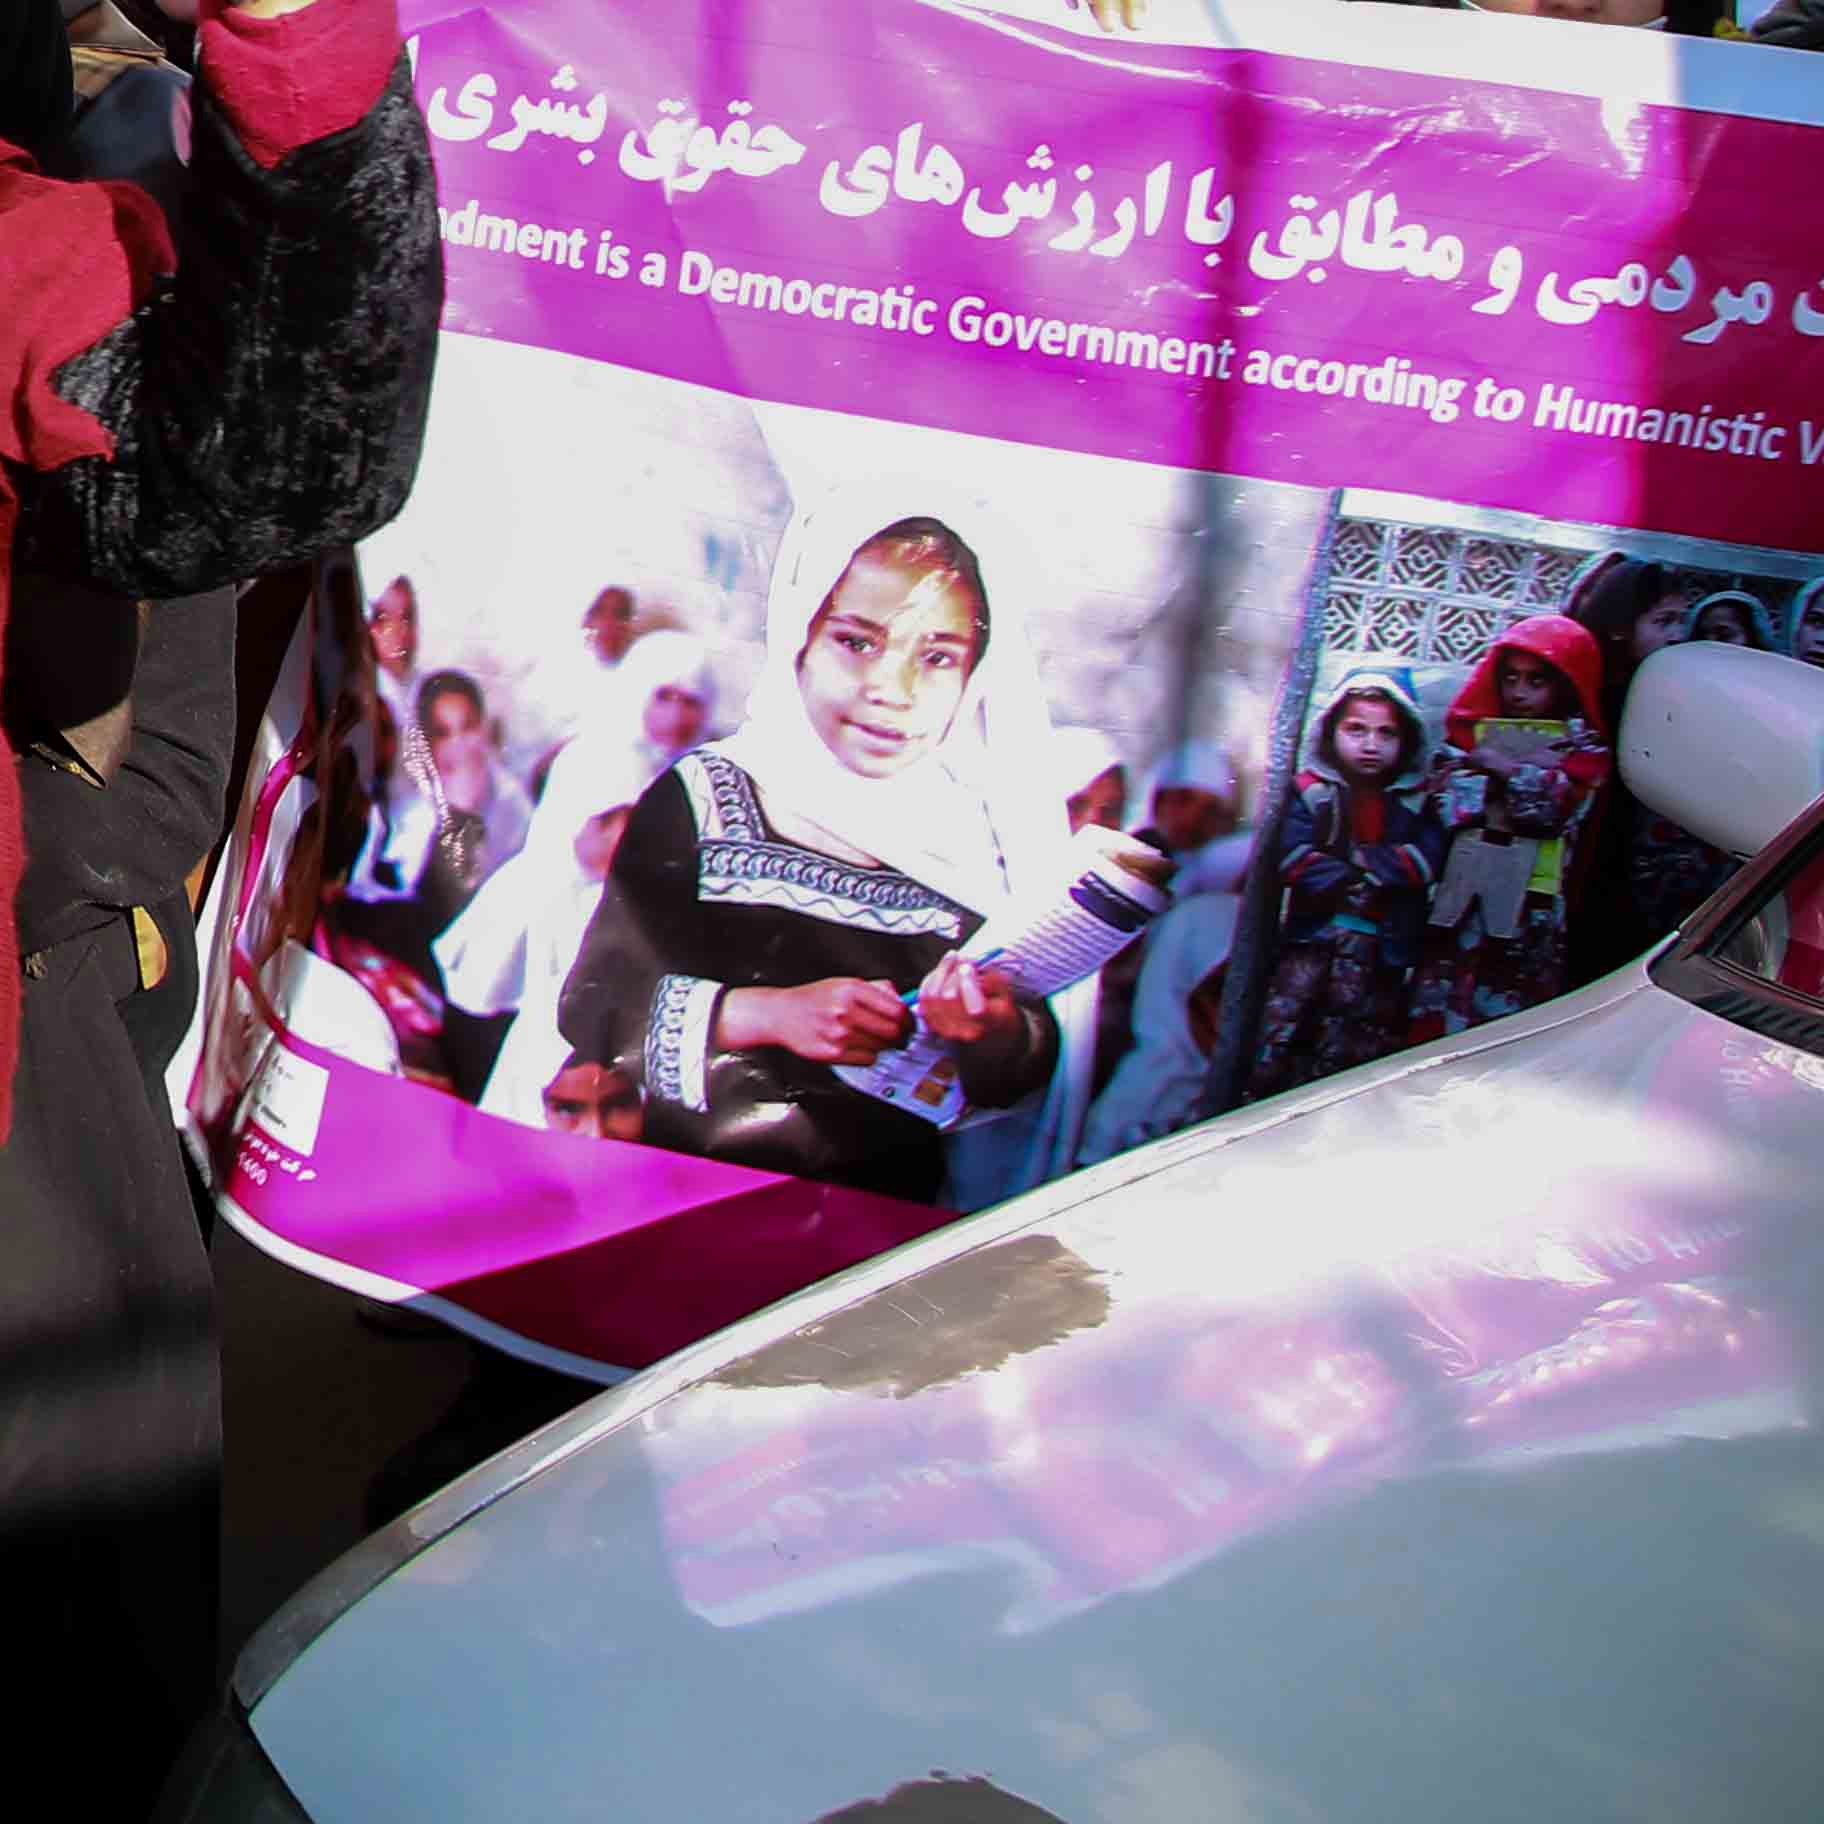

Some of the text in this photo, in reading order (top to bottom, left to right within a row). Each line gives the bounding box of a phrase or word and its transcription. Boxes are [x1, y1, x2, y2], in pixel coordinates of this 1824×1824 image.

[427, 63, 608, 167] بشری
[618, 98, 808, 192] حقوق
[1184, 166, 1235, 269] با
[1248, 190, 1466, 286] مطابق
[1472, 246, 1523, 316] و
[1536, 256, 1773, 346] مردمی
[595, 229, 633, 280] is
[639, 249, 667, 288] a
[678, 251, 938, 336] Democratic
[948, 297, 1233, 381] Government
[1242, 345, 1463, 424] according
[1473, 374, 1525, 423] to
[1533, 383, 1787, 463] Humanistic
